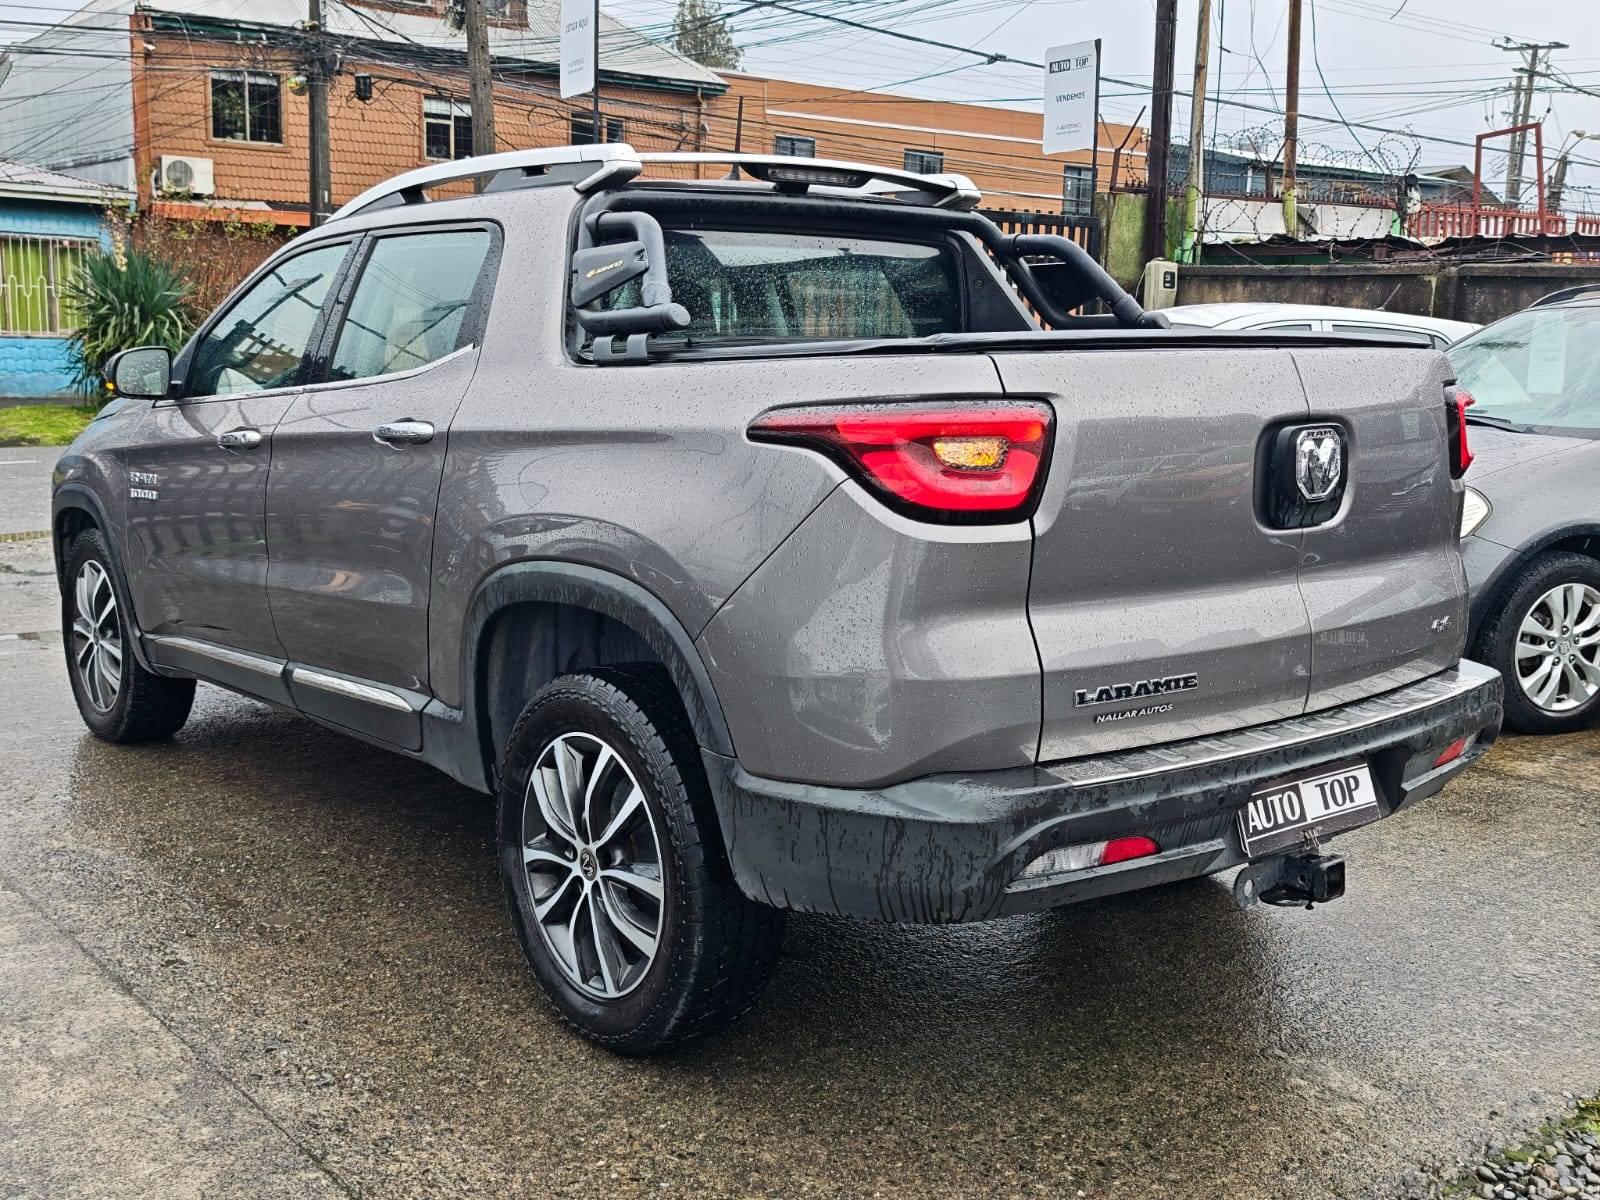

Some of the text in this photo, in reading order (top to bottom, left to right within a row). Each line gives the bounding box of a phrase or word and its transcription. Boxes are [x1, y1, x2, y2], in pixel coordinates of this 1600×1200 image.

[1050, 57, 1089, 72] AUTO TOP
[1055, 91, 1086, 102] VENDEMOS
[1306, 430, 1332, 438] RAM
[1073, 672, 1198, 708] LARAMIE
[1095, 703, 1174, 724] NALLAR AUTOS
[1247, 775, 1360, 833] AUTO TOP
